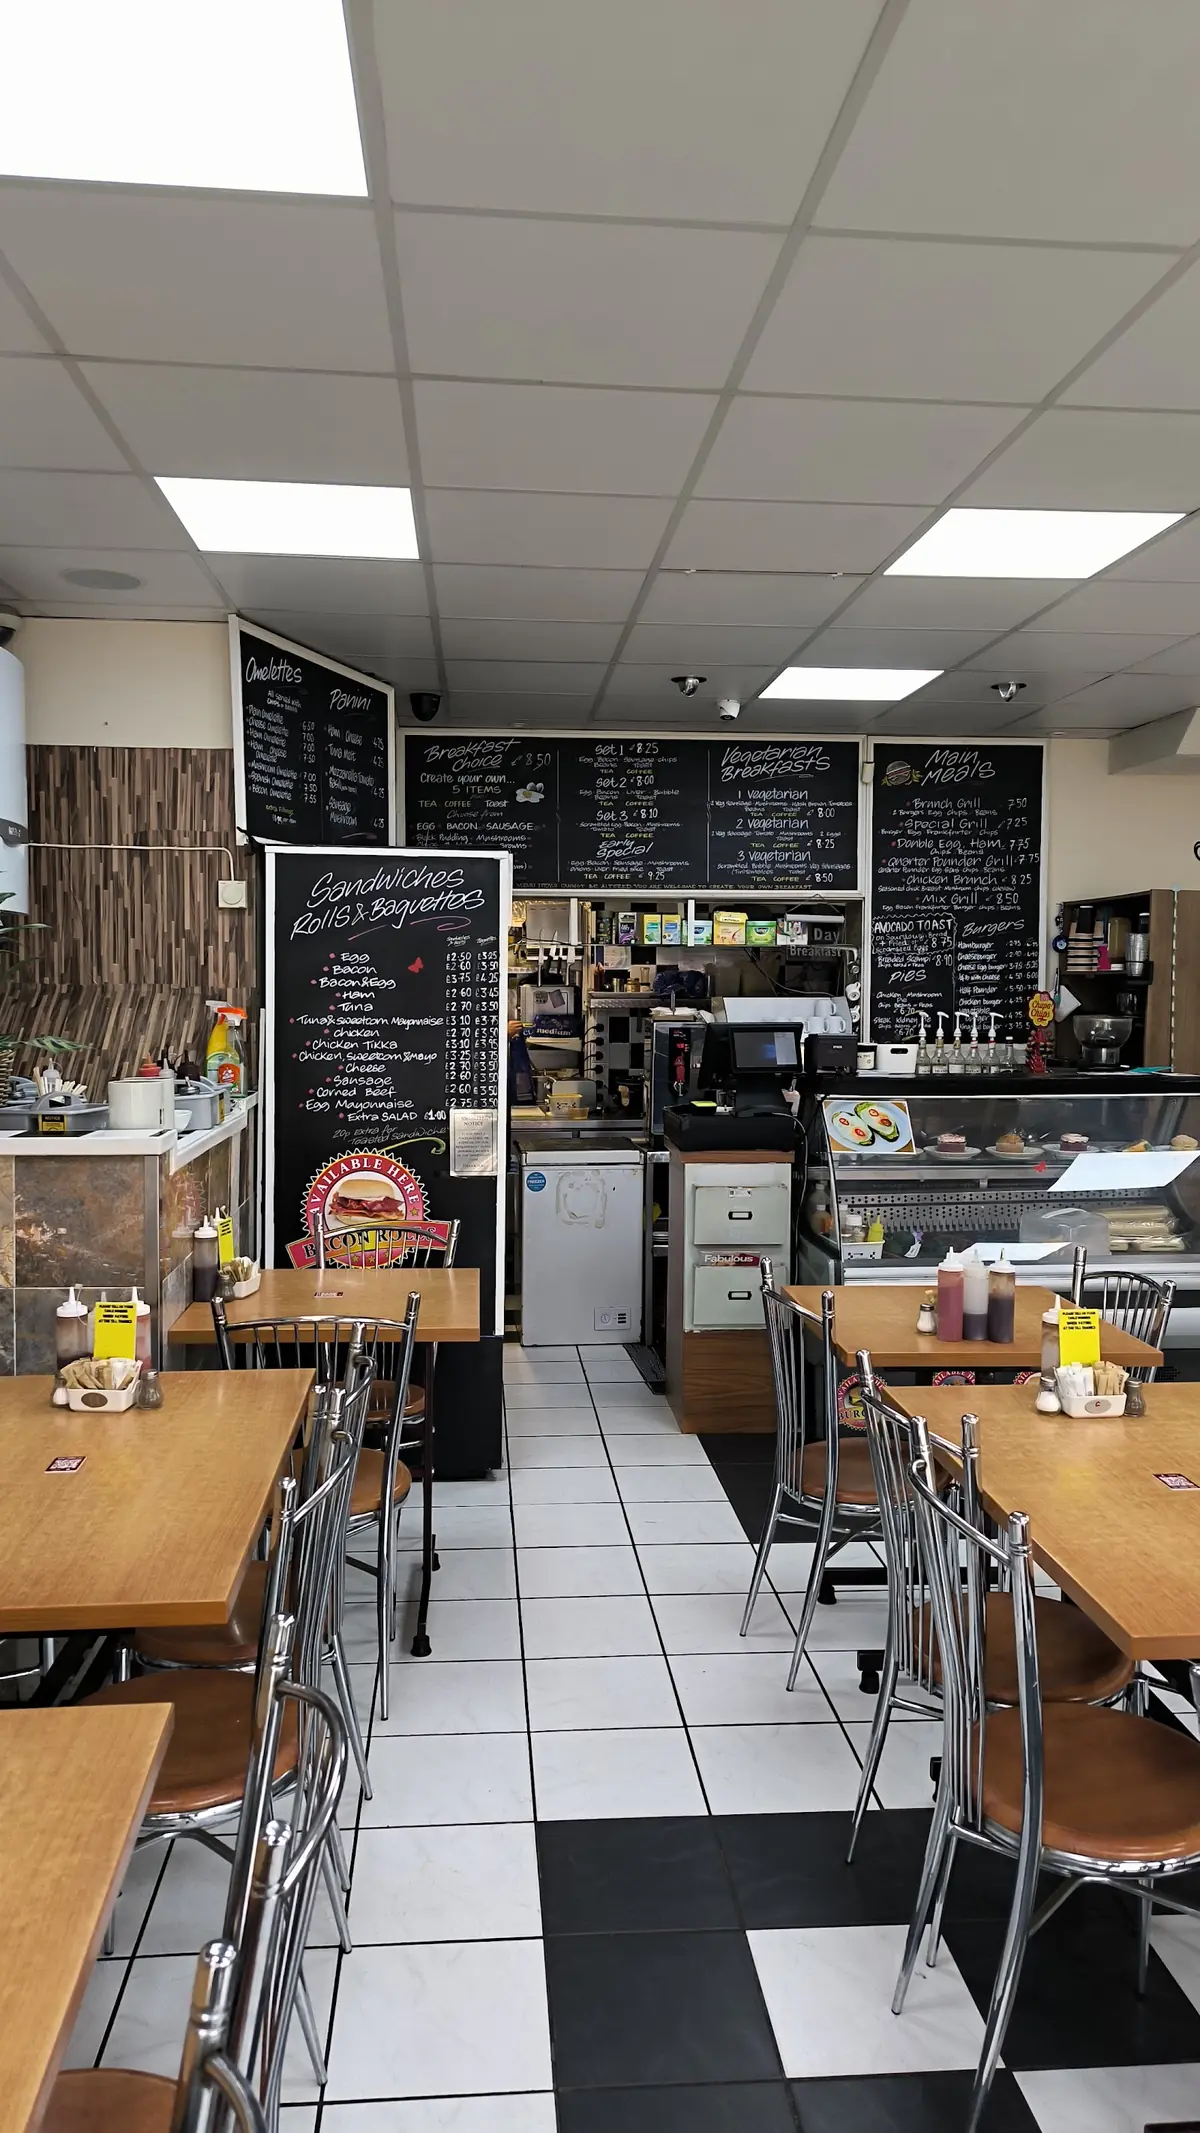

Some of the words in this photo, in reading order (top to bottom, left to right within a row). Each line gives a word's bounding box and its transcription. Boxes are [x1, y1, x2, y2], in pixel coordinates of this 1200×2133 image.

[245, 656, 303, 684] Omelettes
[329, 688, 372, 711] Panini
[423, 738, 521, 763] Breakfast
[595, 743, 618, 756] Set
[619, 744, 624, 756] 1
[720, 744, 824, 768] Vegetarian
[924, 749, 980, 768] Main
[720, 756, 831, 783] Breakfasts
[920, 761, 996, 787] Meals
[420, 773, 454, 784] Create
[457, 774, 483, 785] your
[596, 776, 619, 788] Set
[619, 776, 627, 788] 2
[452, 785, 461, 795] 5
[466, 785, 502, 795] ITEMS
[418, 800, 438, 808] TEA
[444, 800, 472, 808] COFFEE
[484, 799, 510, 808] Toast
[912, 798, 953, 809] Brunch
[957, 797, 981, 809] Grill
[446, 810, 479, 819] Choose
[480, 810, 504, 820] from
[595, 810, 618, 822] Set
[619, 810, 629, 821] 3
[416, 822, 436, 831] EGG
[446, 822, 478, 831] BACON
[485, 822, 534, 831] SAUSAGE
[735, 818, 744, 830] 2
[904, 818, 955, 830] Special
[959, 818, 988, 830] Grill
[438, 833, 469, 844] Pudding
[598, 839, 635, 850] Early
[896, 838, 934, 849] Double
[970, 838, 1001, 848] Ham
[595, 841, 654, 861] Special
[736, 850, 746, 862] 3
[887, 856, 930, 868] Quarter
[932, 855, 982, 867] Pounder
[985, 854, 1013, 868] Grill
[906, 874, 949, 885] Chicken
[953, 874, 998, 885] Brunch
[306, 866, 465, 908] Sandwiches
[921, 894, 947, 904] Mix
[950, 892, 978, 905] Grill
[290, 905, 351, 940] Rolls
[368, 889, 486, 930] Baguettes
[874, 921, 915, 934] AVOCADO
[917, 919, 953, 931] TOAST
[962, 919, 1025, 938] Burgers
[814, 928, 841, 944] Day
[340, 952, 371, 964] Egg
[332, 965, 378, 975] Bacon
[342, 990, 376, 1000] Ham
[337, 1002, 374, 1013] Tuna
[390, 1016, 444, 1031] Mayonnaise
[536, 1028, 571, 1036] medium
[312, 1037, 359, 1050] Chicken
[345, 1063, 387, 1074] Cheese
[333, 1075, 393, 1087] Sausage
[316, 1087, 357, 1098] Corned
[365, 1088, 398, 1098] Beef
[305, 1100, 331, 1112] Egg
[334, 1099, 415, 1112] Mayonnaise
[347, 1112, 379, 1122] Extra
[381, 1111, 418, 1122] SALAD
[332, 1129, 351, 1140] 20p
[353, 1127, 380, 1137] Extra
[381, 1125, 399, 1137] for
[309, 1156, 383, 1215] AVAILABLE
[386, 1165, 420, 1205] HERE
[704, 1254, 754, 1263] Fabulous
